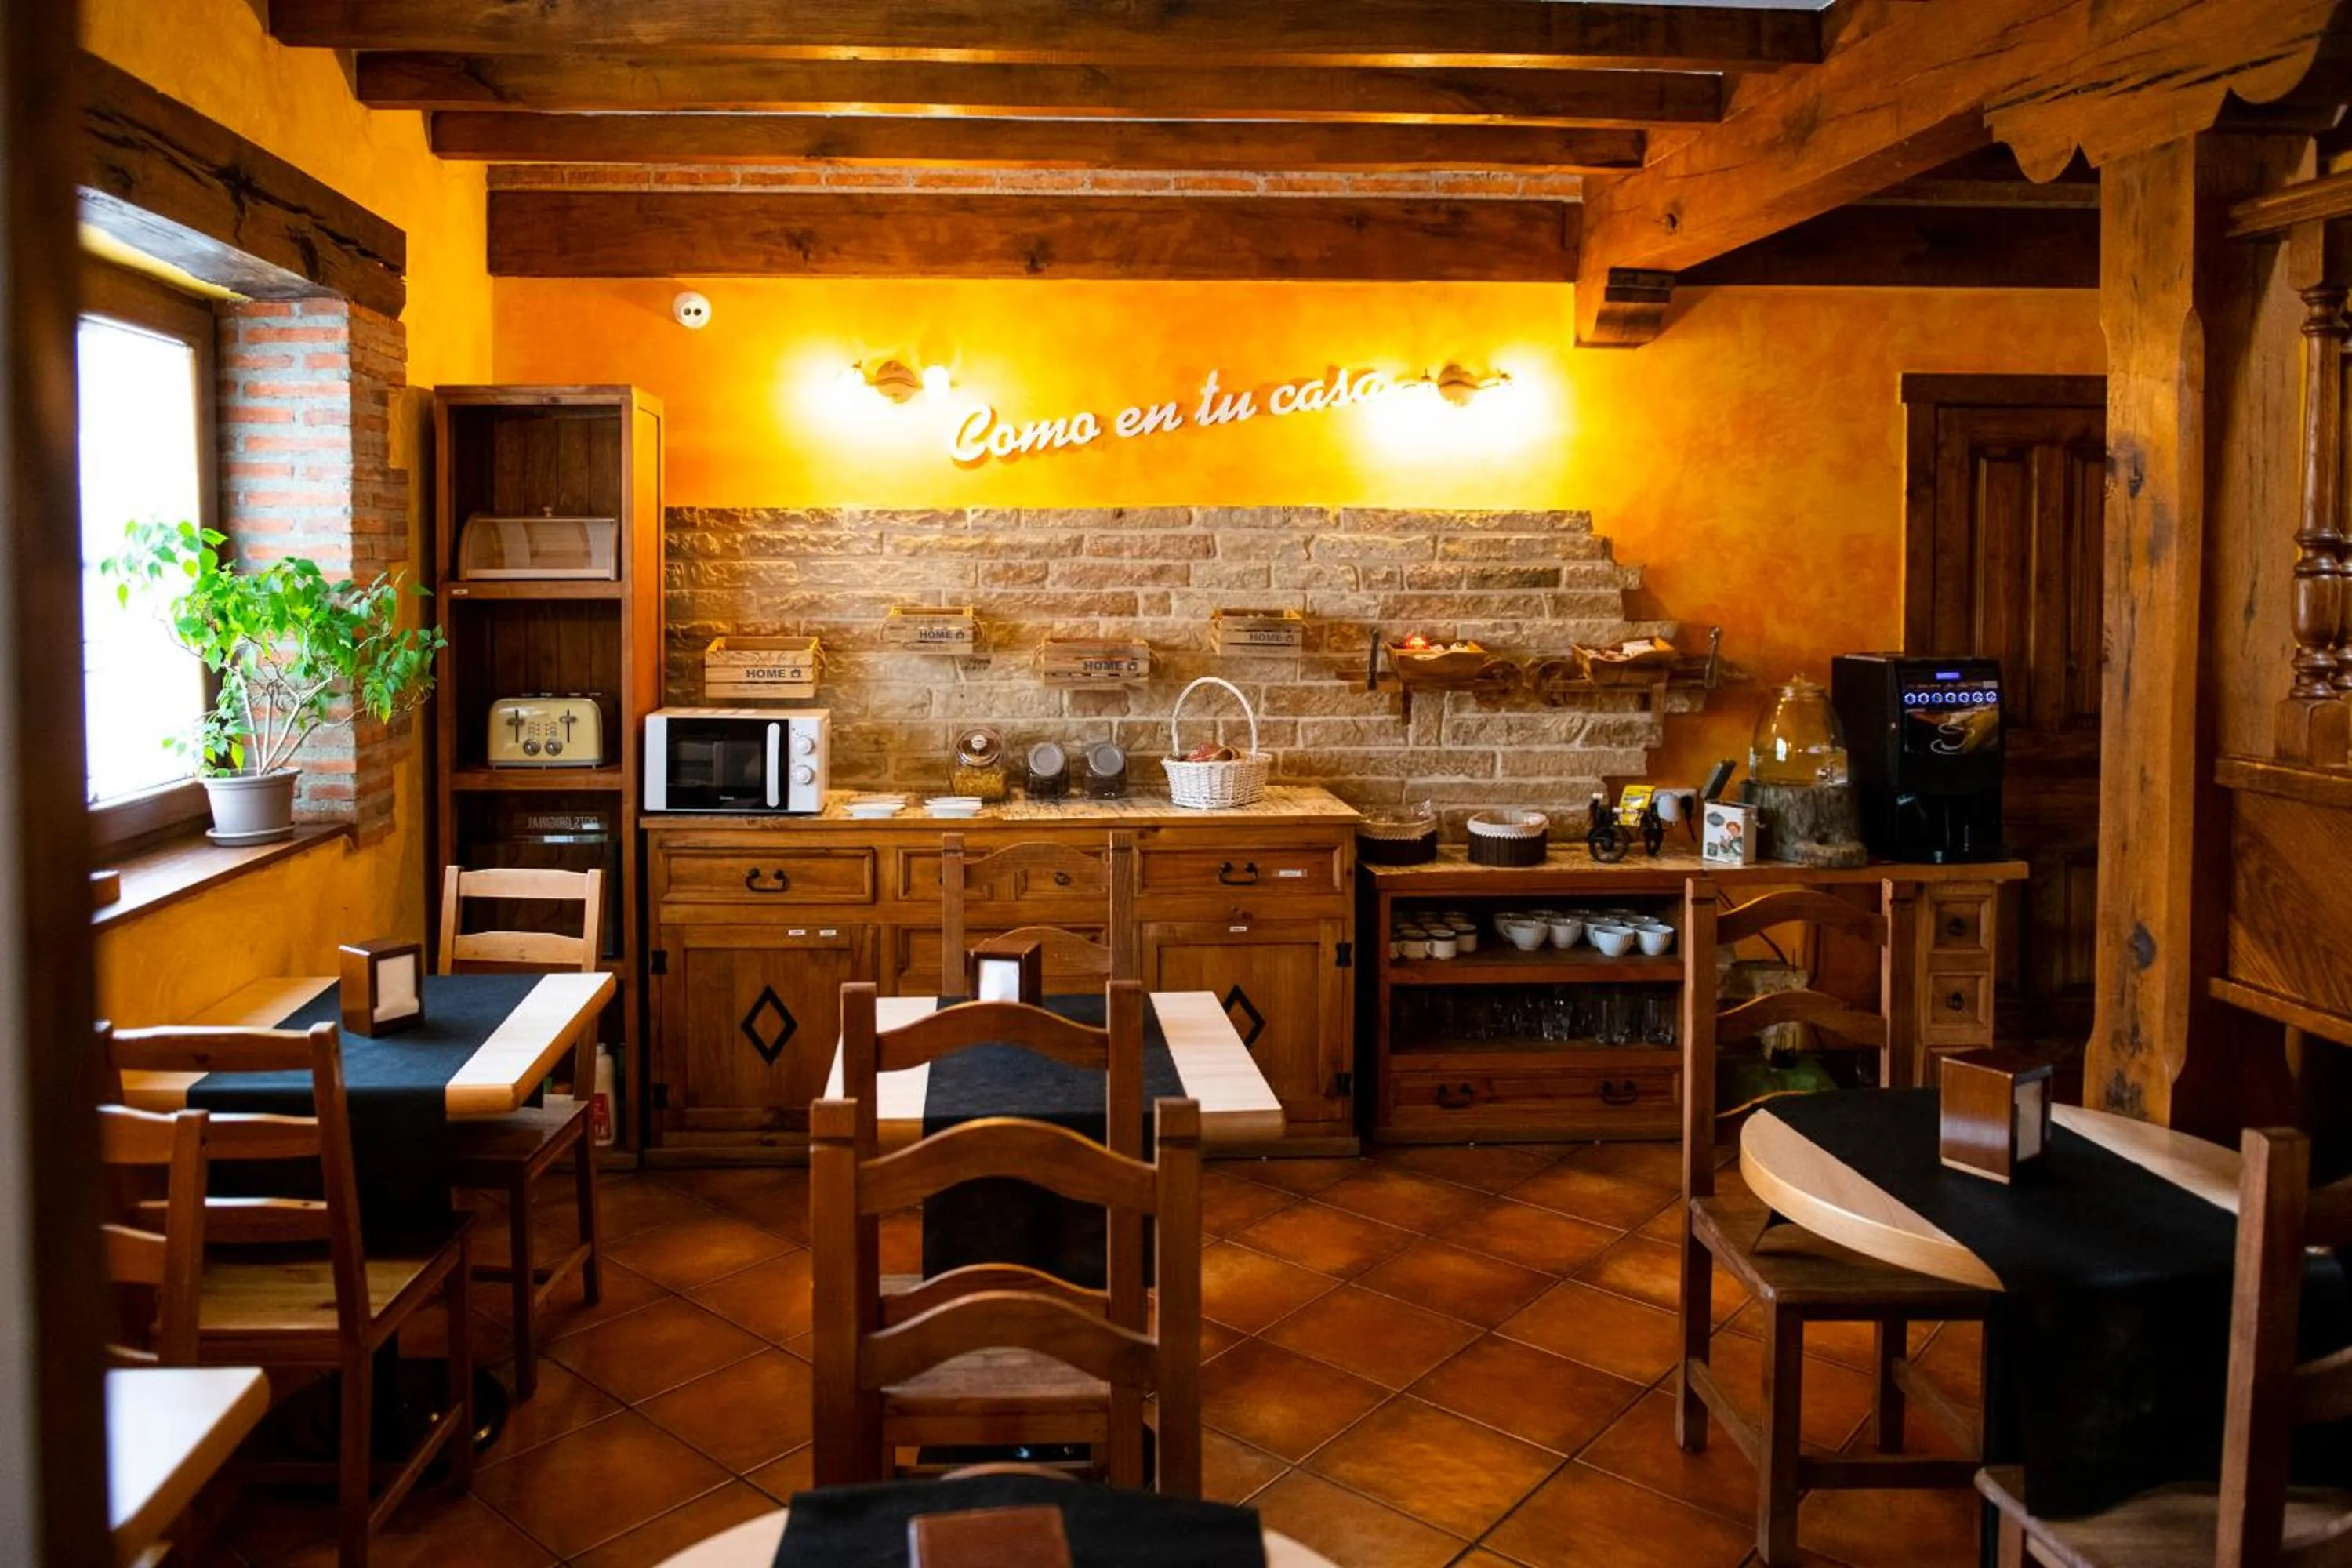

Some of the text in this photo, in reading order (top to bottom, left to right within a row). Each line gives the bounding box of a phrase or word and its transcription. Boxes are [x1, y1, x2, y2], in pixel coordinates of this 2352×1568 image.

[950, 367, 1391, 461] Como en tu casa
[919, 629, 953, 638] HOME
[1248, 633, 1283, 642] HOME
[1084, 661, 1123, 670] HOME
[746, 669, 786, 678] HOME
